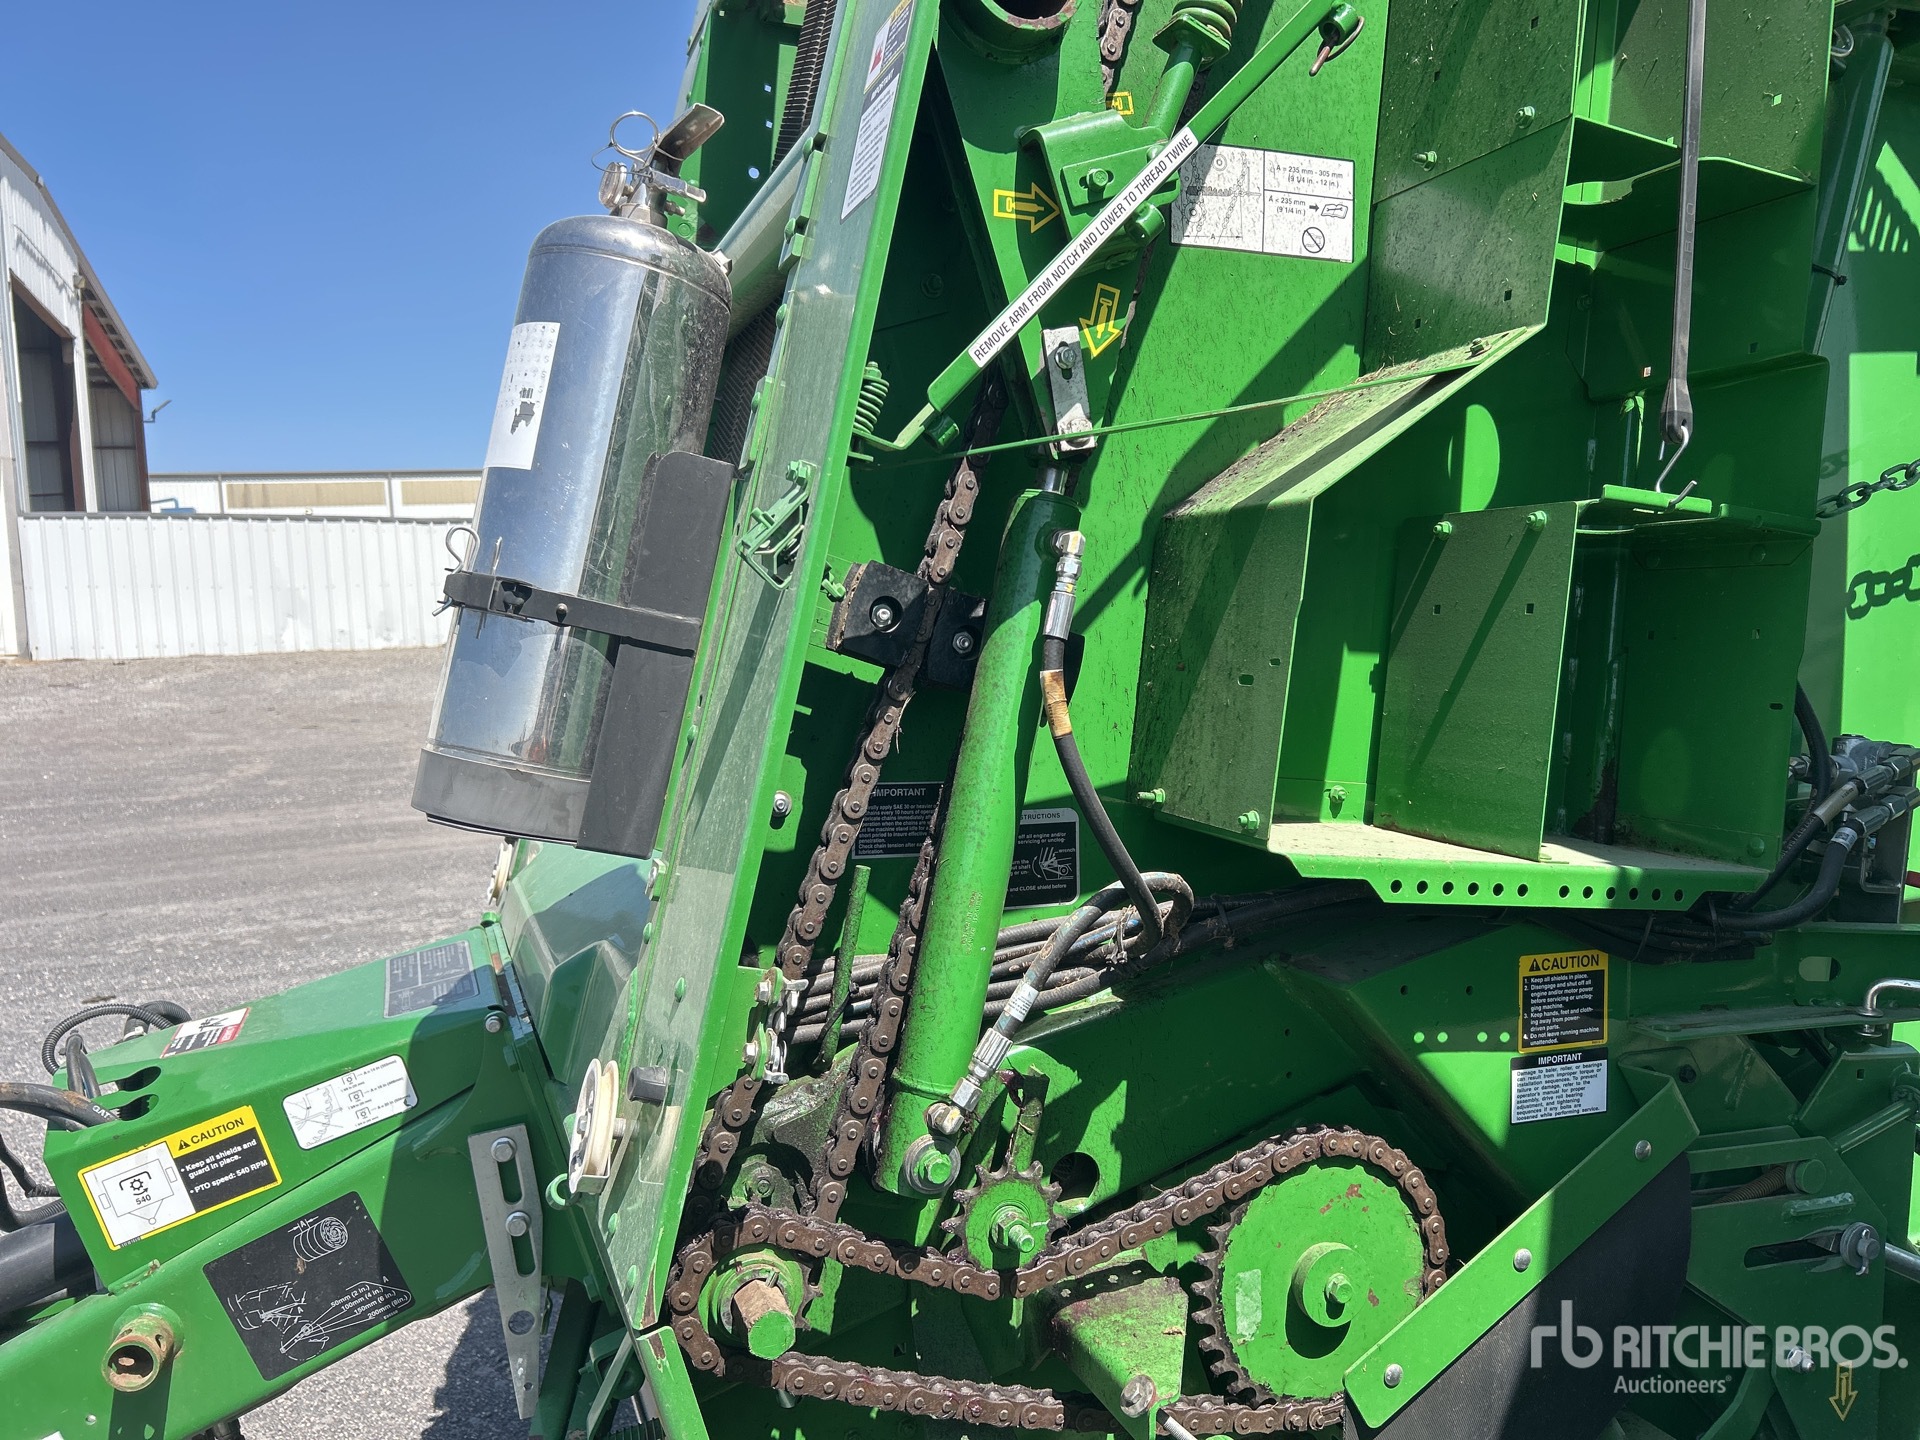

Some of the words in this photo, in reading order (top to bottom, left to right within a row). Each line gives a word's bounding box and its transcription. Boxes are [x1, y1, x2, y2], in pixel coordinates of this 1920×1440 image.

[973, 324, 1011, 361] REMOVE
[1009, 301, 1030, 327] ARM
[1027, 278, 1054, 307] FROM
[1051, 249, 1082, 282] NOTCH
[1079, 236, 1099, 254] AND
[1097, 205, 1129, 237] LOWER
[1123, 192, 1138, 209] TO
[1135, 159, 1168, 198] THREAD
[1165, 134, 1193, 165] TWINE
[874, 788, 926, 797] IMPORTANT
[1541, 954, 1599, 970] CAUTION
[1538, 1053, 1582, 1065] IMPORTANT
[191, 1118, 245, 1145] CAUTION
[185, 1161, 206, 1172] Keep
[206, 1155, 215, 1165] all
[216, 1147, 242, 1161] shields
[243, 1139, 257, 1150] and
[189, 1168, 210, 1179] guard
[211, 1162, 218, 1170] in
[219, 1154, 242, 1169] place.
[194, 1183, 211, 1194] PTO
[212, 1173, 236, 1187] speed:
[237, 1167, 250, 1178] 540
[251, 1160, 268, 1172] RPM
[135, 1194, 151, 1206] 540
[331, 1293, 351, 1308] 50mm
[341, 1298, 365, 1311] 100mm
[367, 1305, 391, 1319] 200mm
